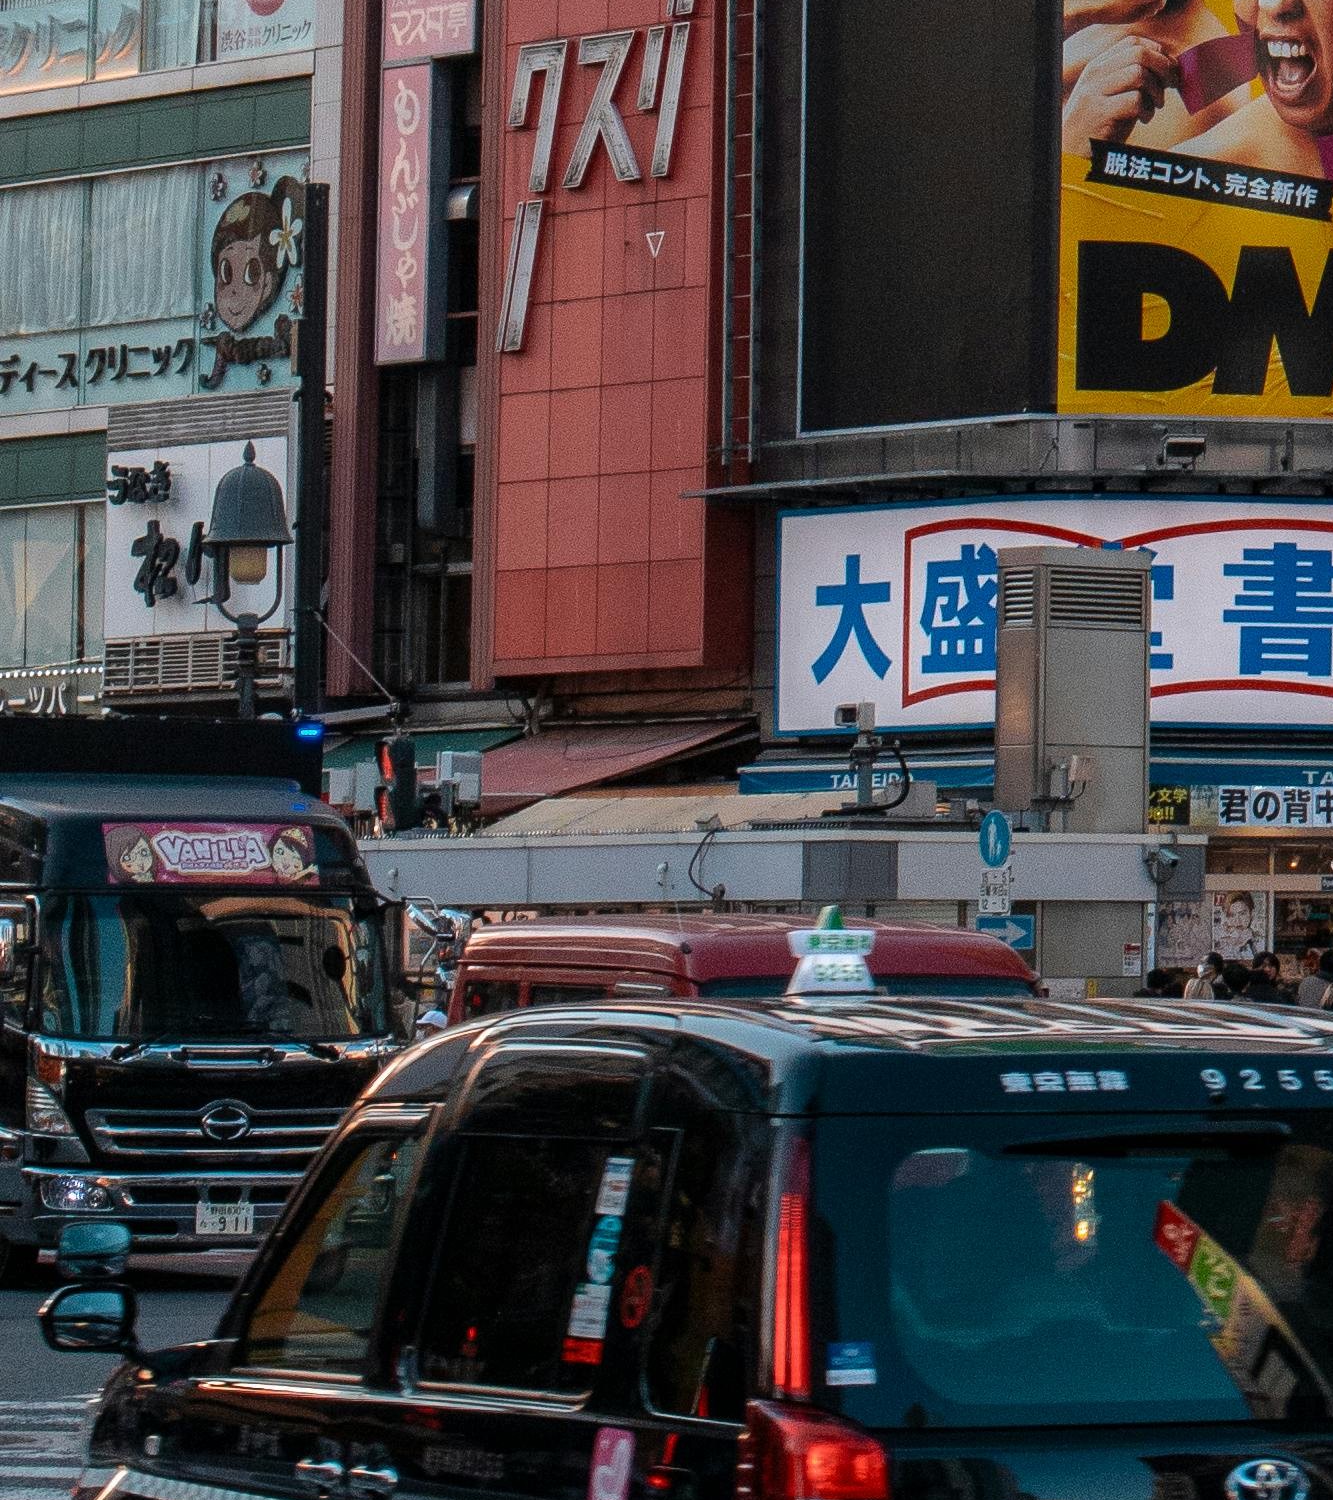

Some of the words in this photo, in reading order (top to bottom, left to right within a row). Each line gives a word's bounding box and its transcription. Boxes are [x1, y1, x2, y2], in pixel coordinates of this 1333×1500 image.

[507, 21, 692, 194] クスリ
[1102, 150, 1319, 211] 脱法コント、完全新作
